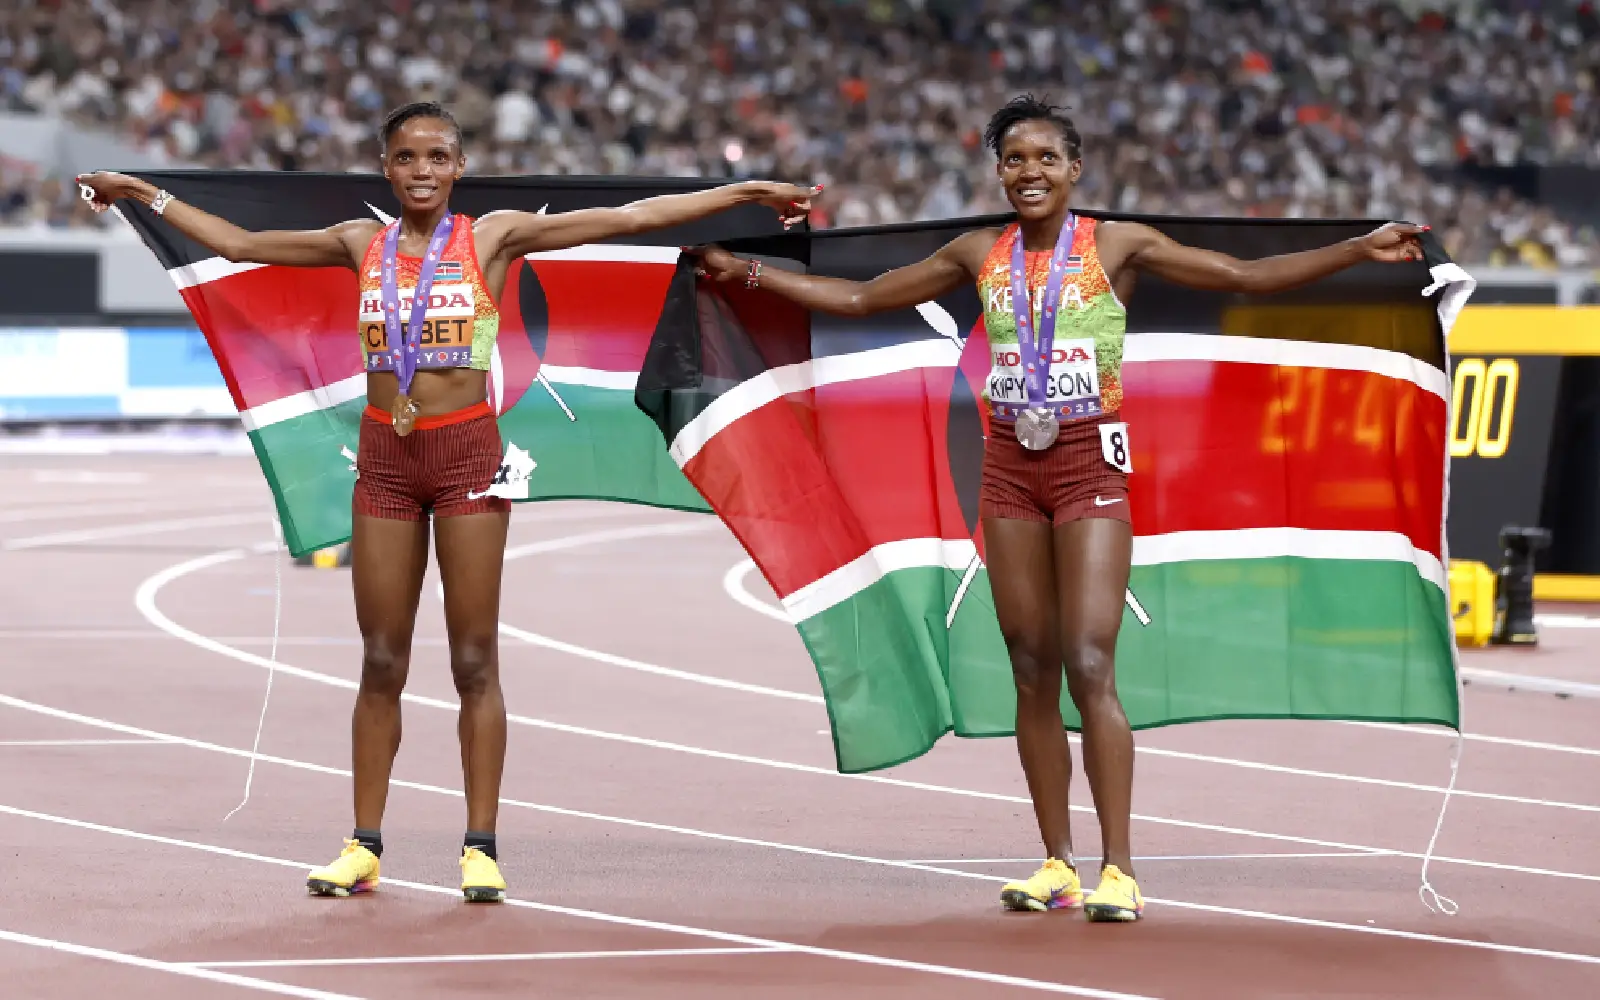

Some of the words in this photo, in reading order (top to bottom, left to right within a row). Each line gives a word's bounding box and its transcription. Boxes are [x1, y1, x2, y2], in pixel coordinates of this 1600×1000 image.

[988, 283, 1084, 313] KENA
[993, 347, 1091, 367] HODA
[990, 371, 1094, 399] KIPYGON
[1449, 357, 1519, 458] 00
[1110, 431, 1126, 466] 8
